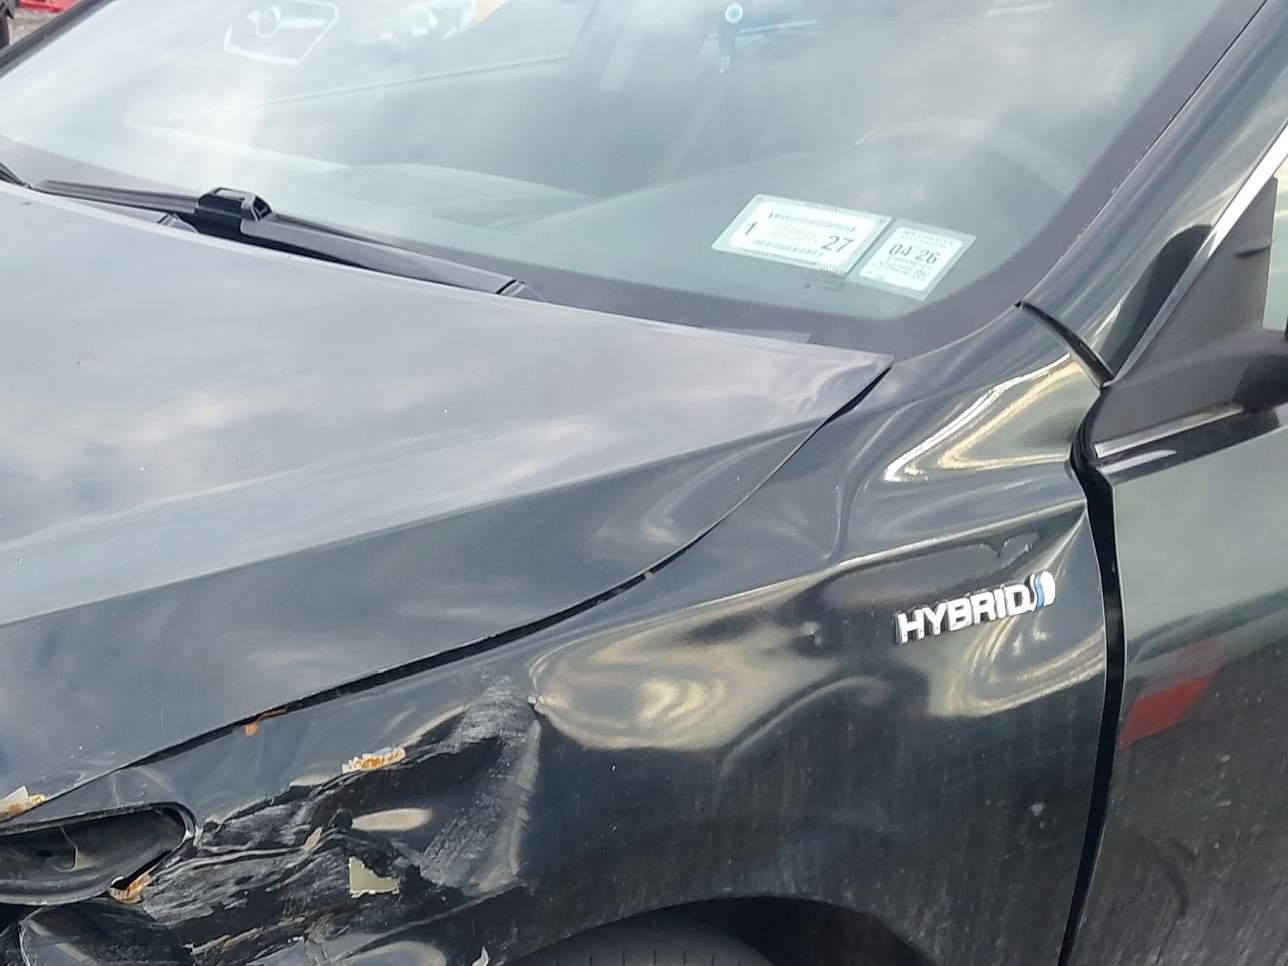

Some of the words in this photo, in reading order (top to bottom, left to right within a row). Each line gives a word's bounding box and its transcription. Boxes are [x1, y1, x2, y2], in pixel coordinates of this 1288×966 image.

[820, 234, 855, 253] 27
[888, 243, 913, 257] 04
[914, 248, 942, 265] 26
[895, 583, 1037, 645] HYBRID
